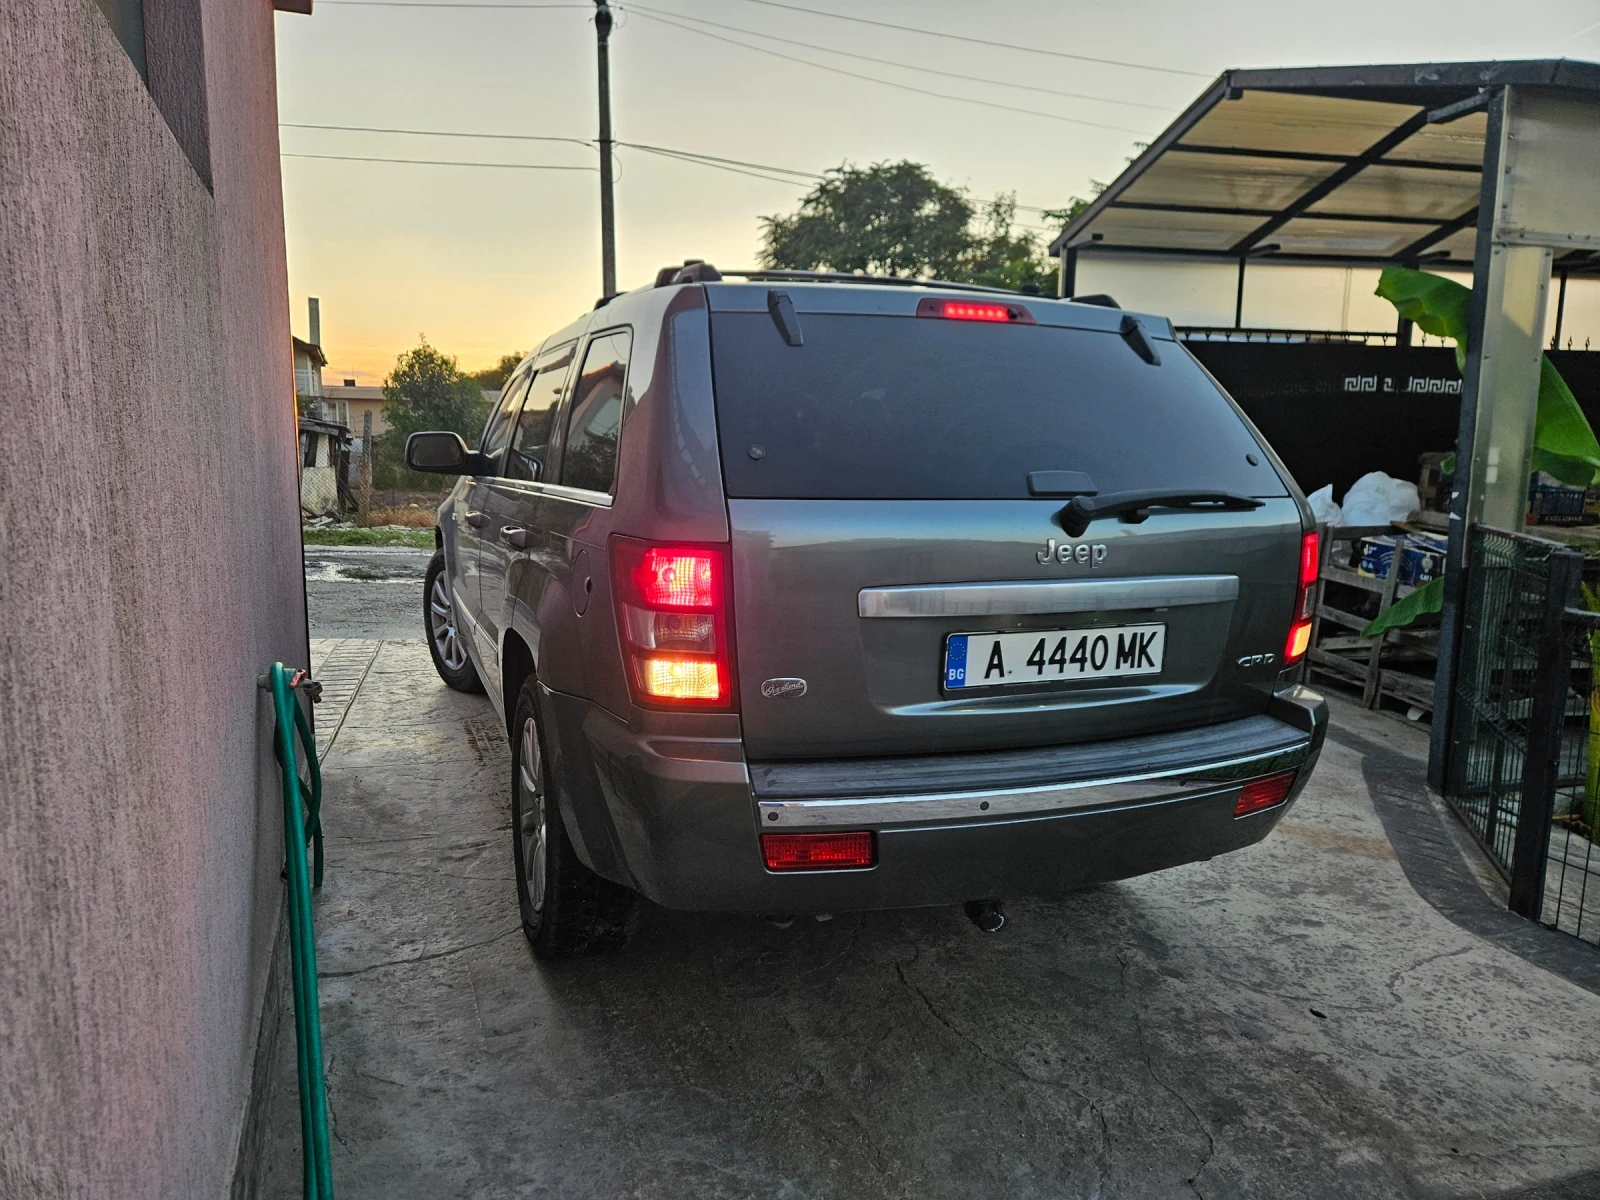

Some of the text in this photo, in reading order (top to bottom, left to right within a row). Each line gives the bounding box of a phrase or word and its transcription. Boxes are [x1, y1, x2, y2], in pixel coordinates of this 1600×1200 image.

[1036, 538, 1107, 568] Jeep
[984, 631, 1157, 679] A 4440 MK
[948, 667, 964, 680] BG
